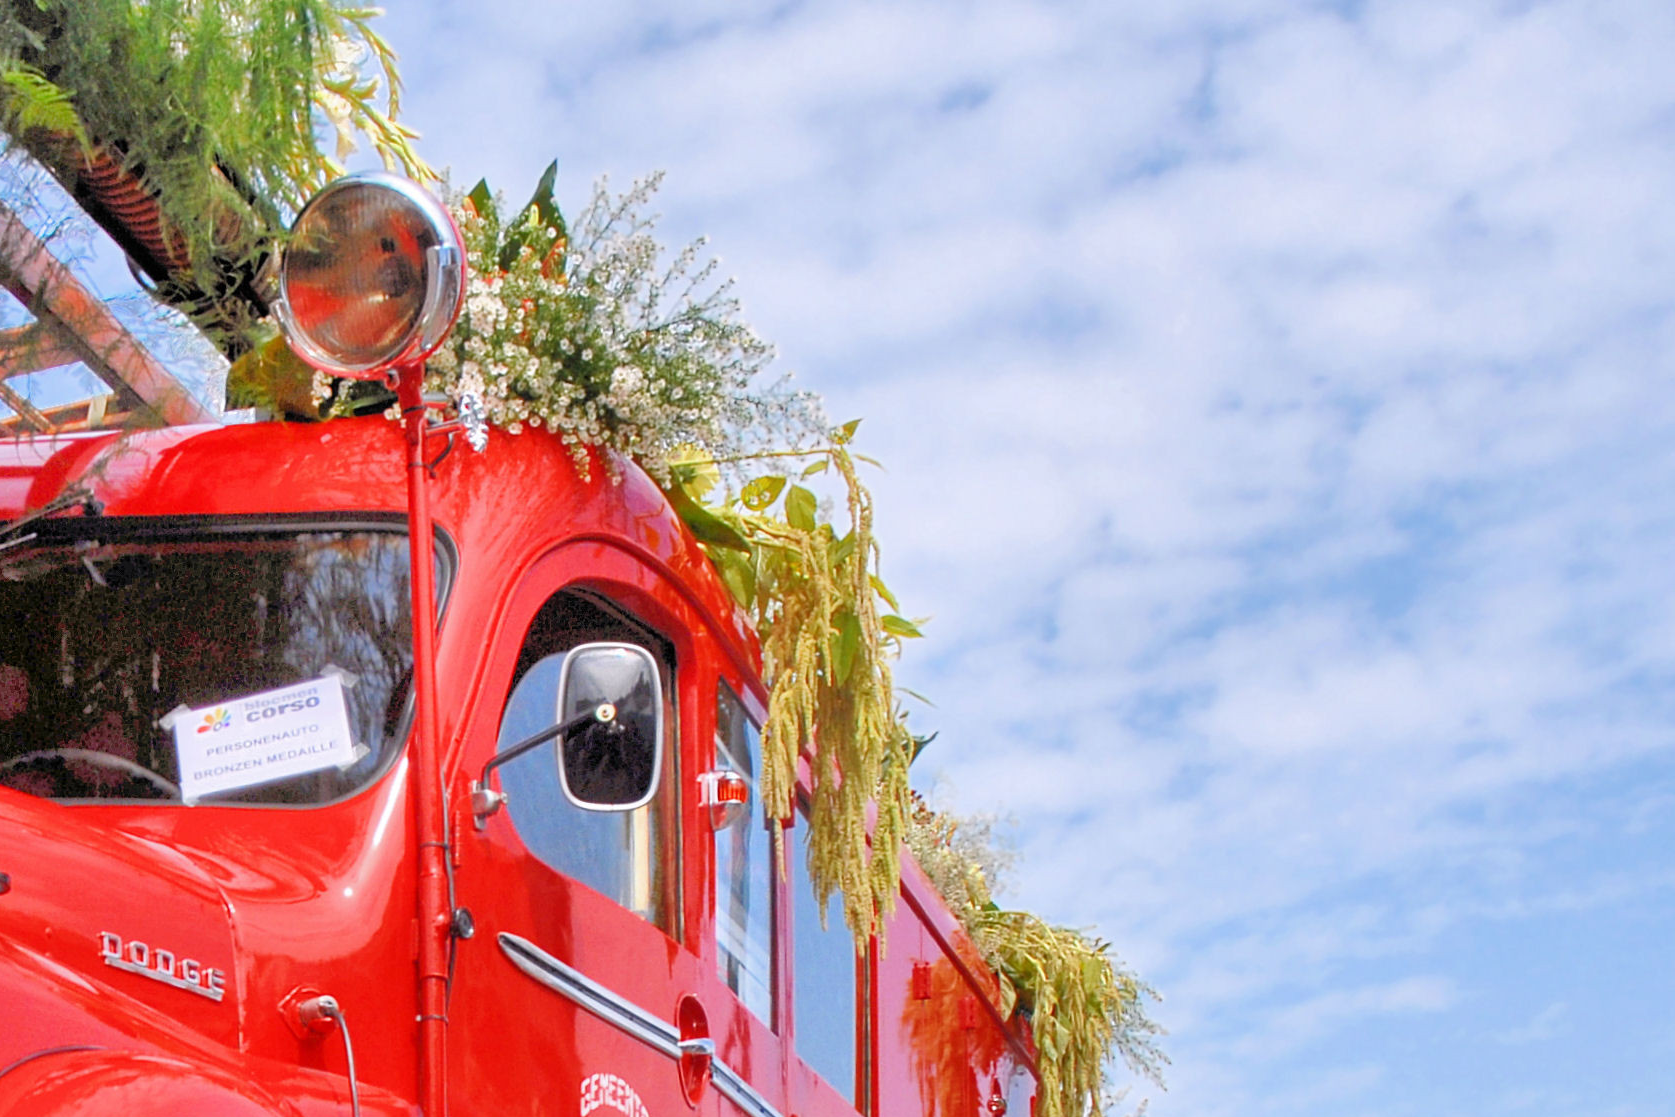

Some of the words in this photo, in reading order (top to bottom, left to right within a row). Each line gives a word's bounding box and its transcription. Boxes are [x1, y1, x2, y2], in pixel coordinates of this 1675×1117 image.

[244, 687, 319, 712] bloemen
[246, 696, 320, 723] corso
[206, 724, 320, 757] PERSONENAUTO
[194, 757, 263, 781] BRONZEN
[266, 740, 338, 765] MEDAILLE
[98, 931, 225, 995] DODGE
